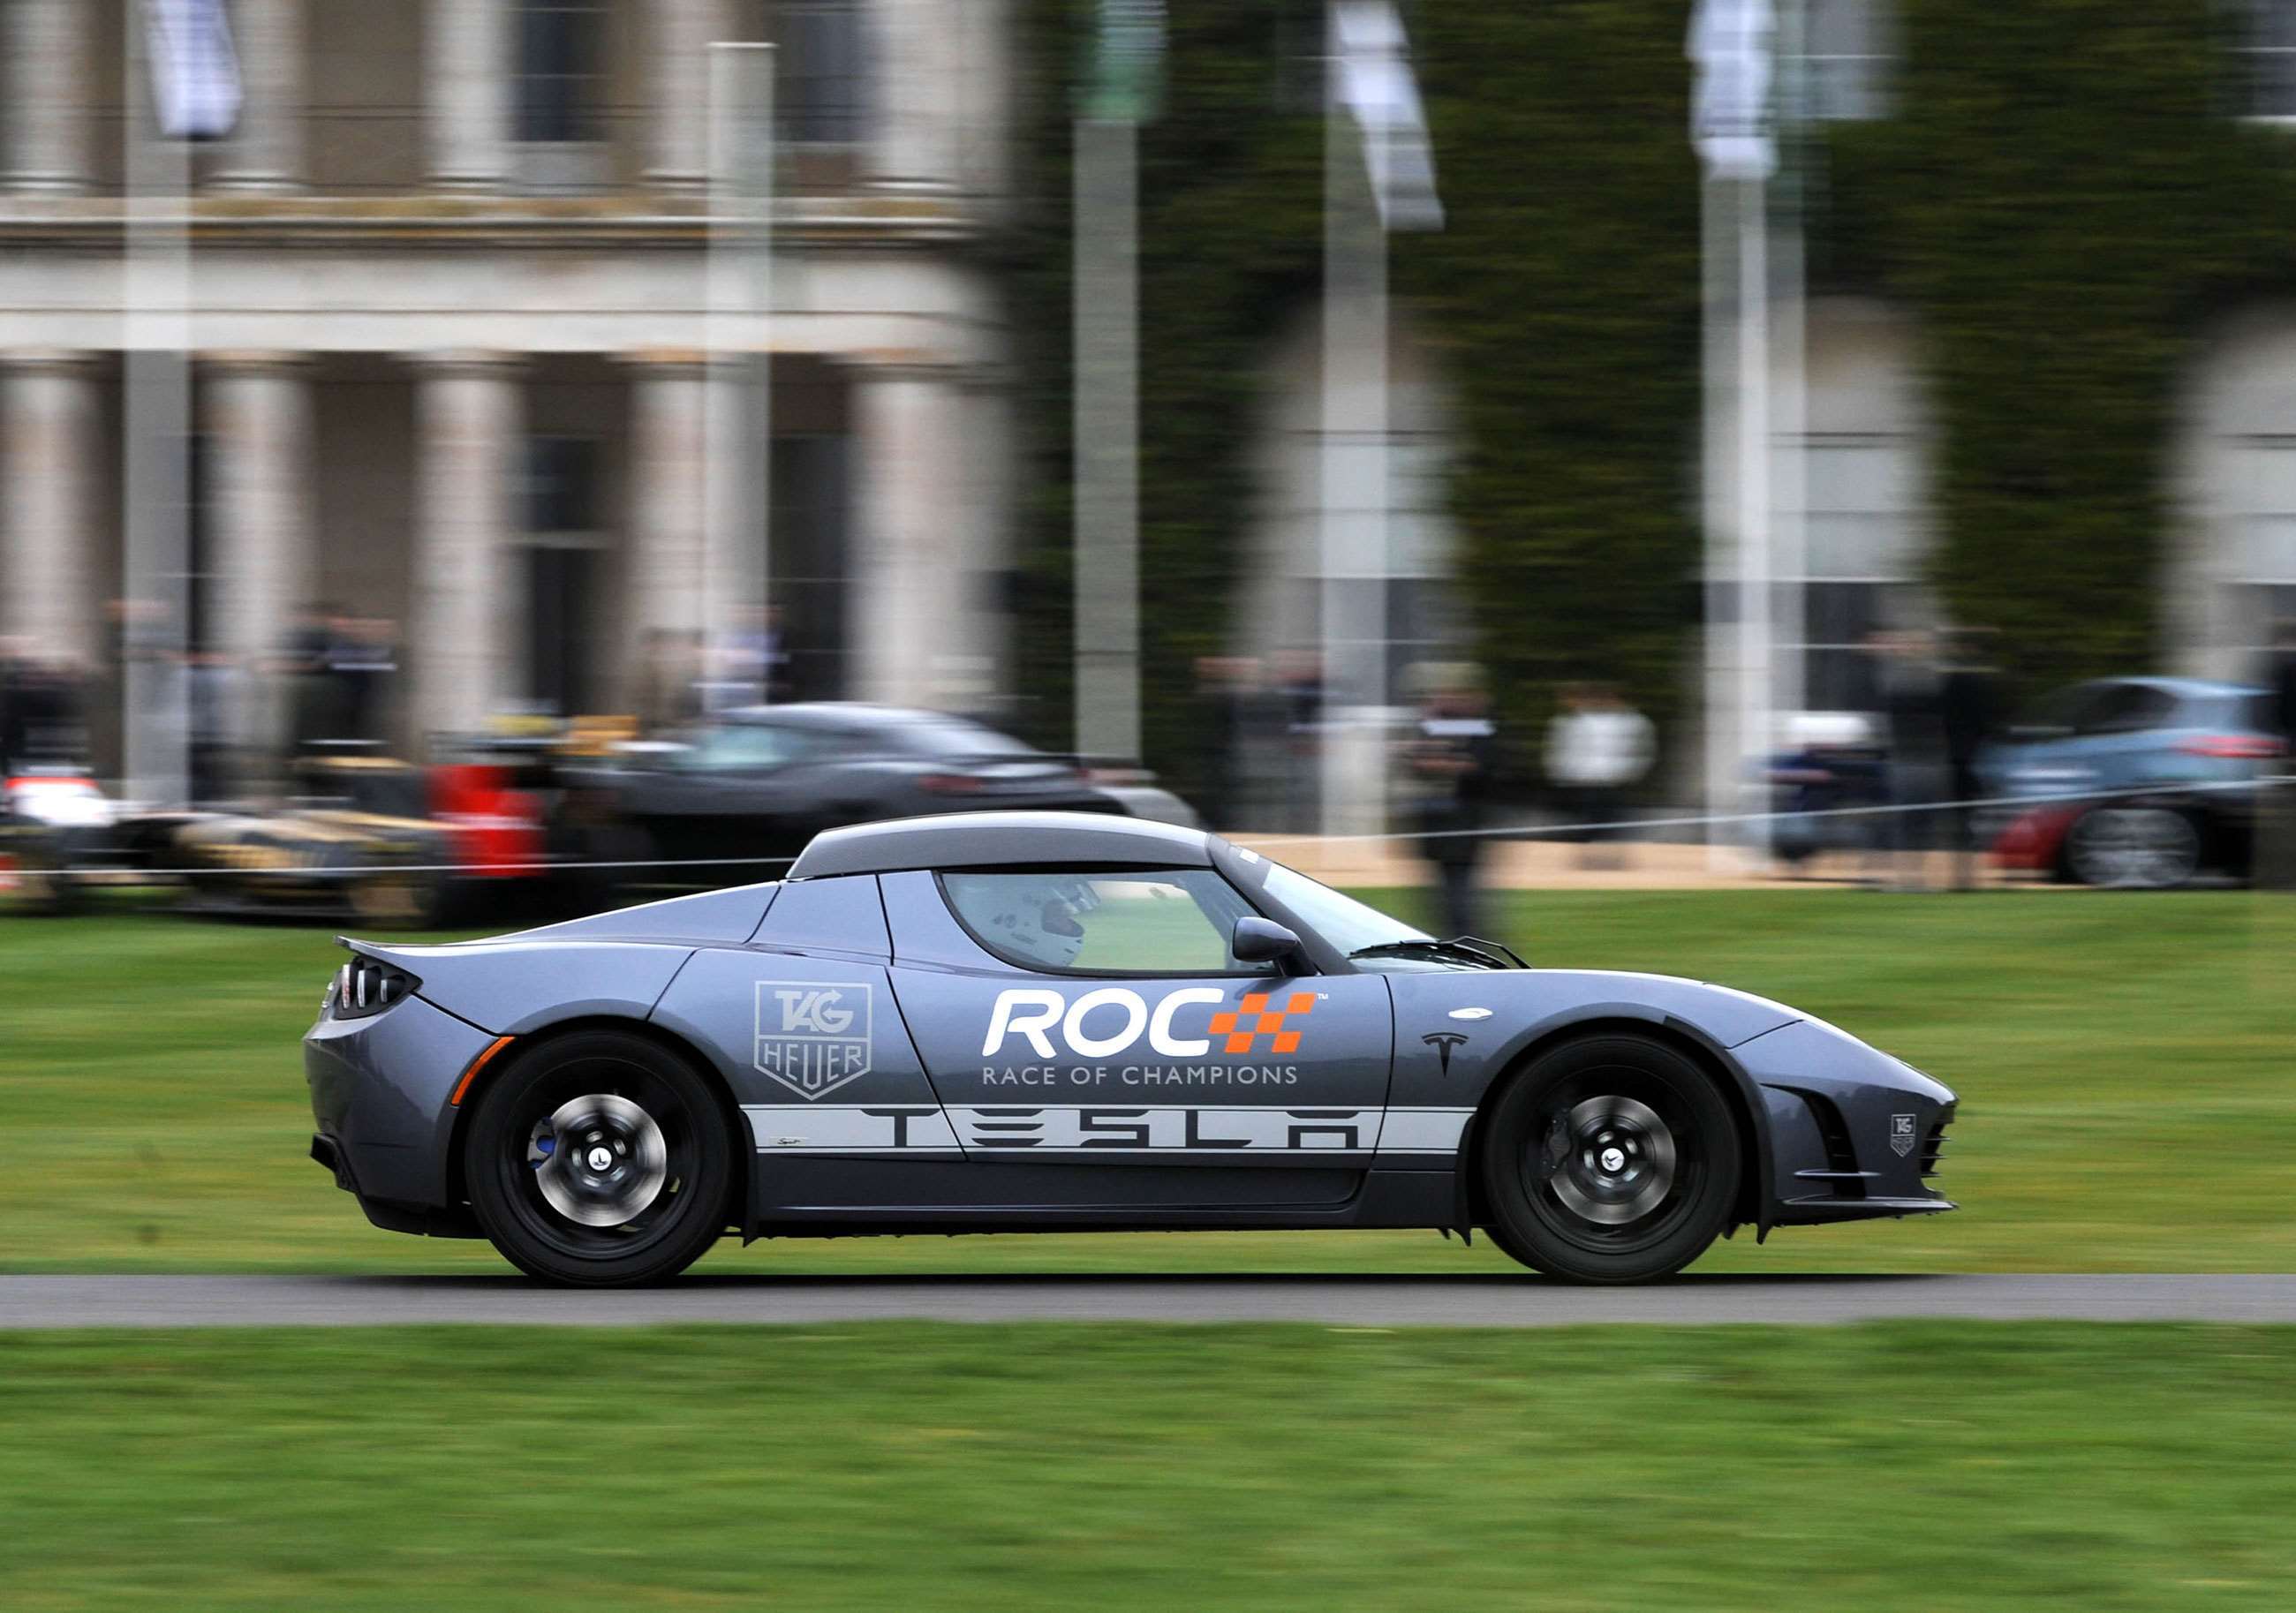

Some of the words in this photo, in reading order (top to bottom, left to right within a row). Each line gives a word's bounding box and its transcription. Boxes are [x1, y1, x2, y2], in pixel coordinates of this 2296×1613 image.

[775, 990, 853, 1034] TAG
[982, 988, 1224, 1058] ROC
[764, 1043, 862, 1089] HEUER
[983, 1067, 1055, 1085] RACE
[1070, 1067, 1107, 1085] OF
[1122, 1066, 1297, 1085] CHAMPIONS
[859, 1108, 1359, 1148] TESLA
